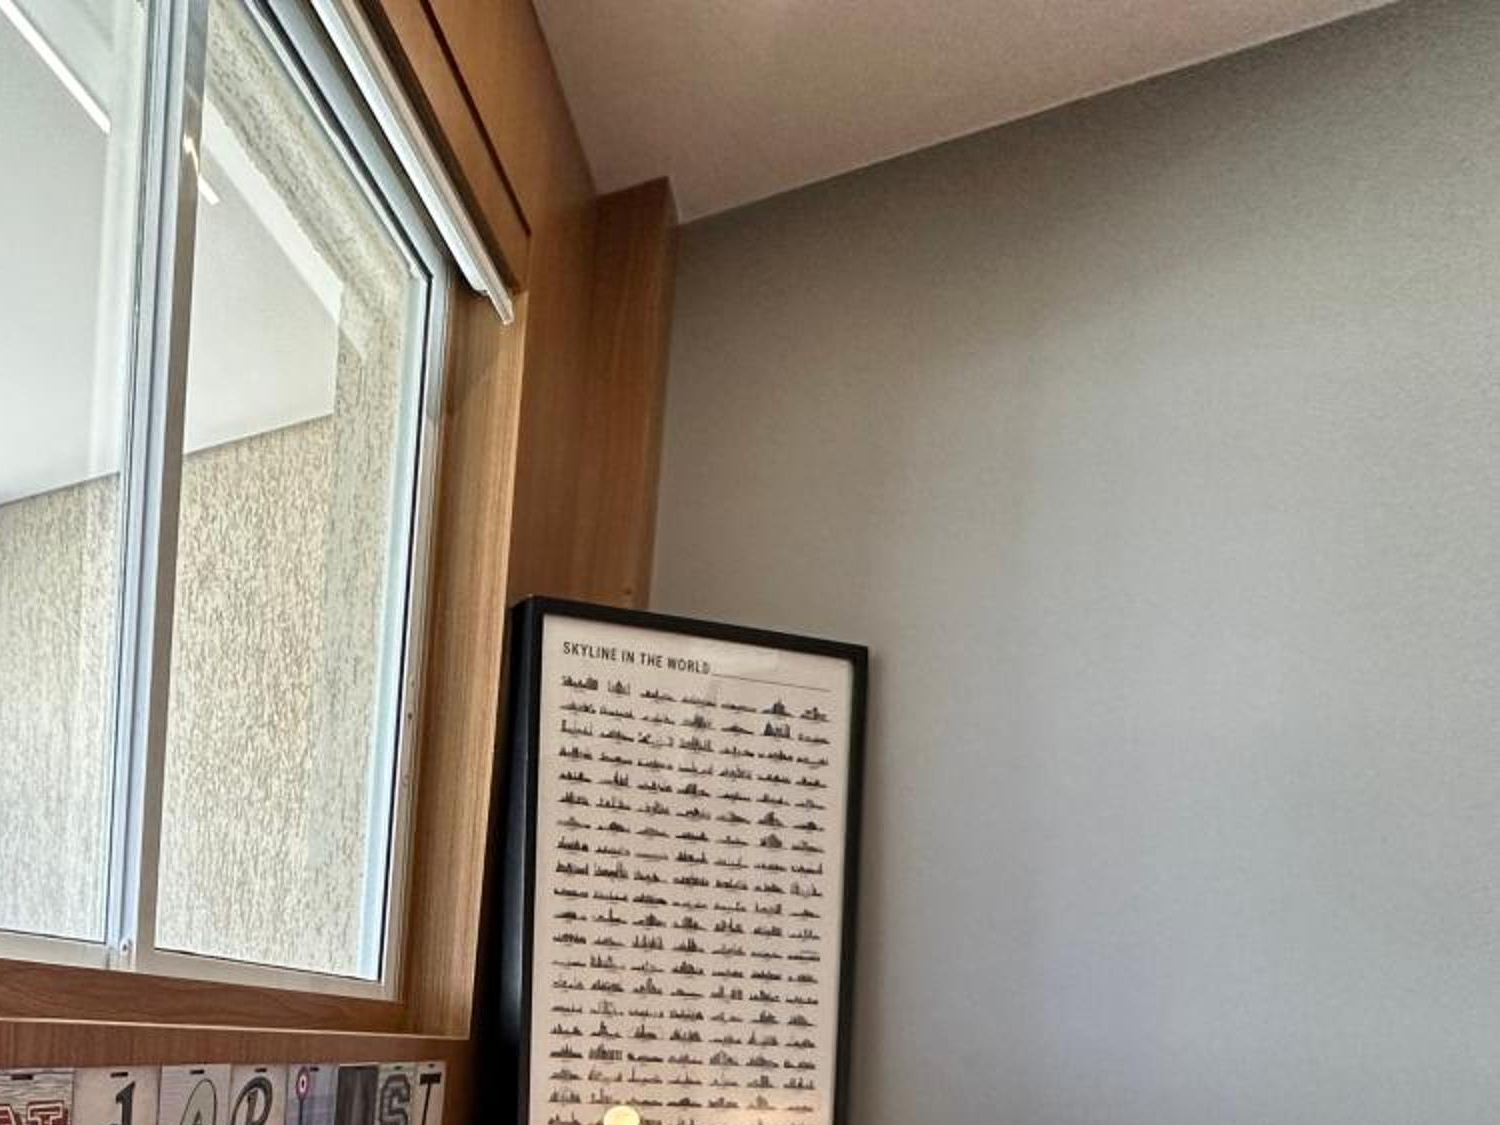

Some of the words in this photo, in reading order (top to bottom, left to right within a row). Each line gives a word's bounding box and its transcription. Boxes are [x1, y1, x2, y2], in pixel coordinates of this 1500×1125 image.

[563, 641, 617, 661] SKYLINE
[622, 650, 635, 664] IN
[640, 652, 663, 669] THE
[667, 658, 710, 675] WORLD
